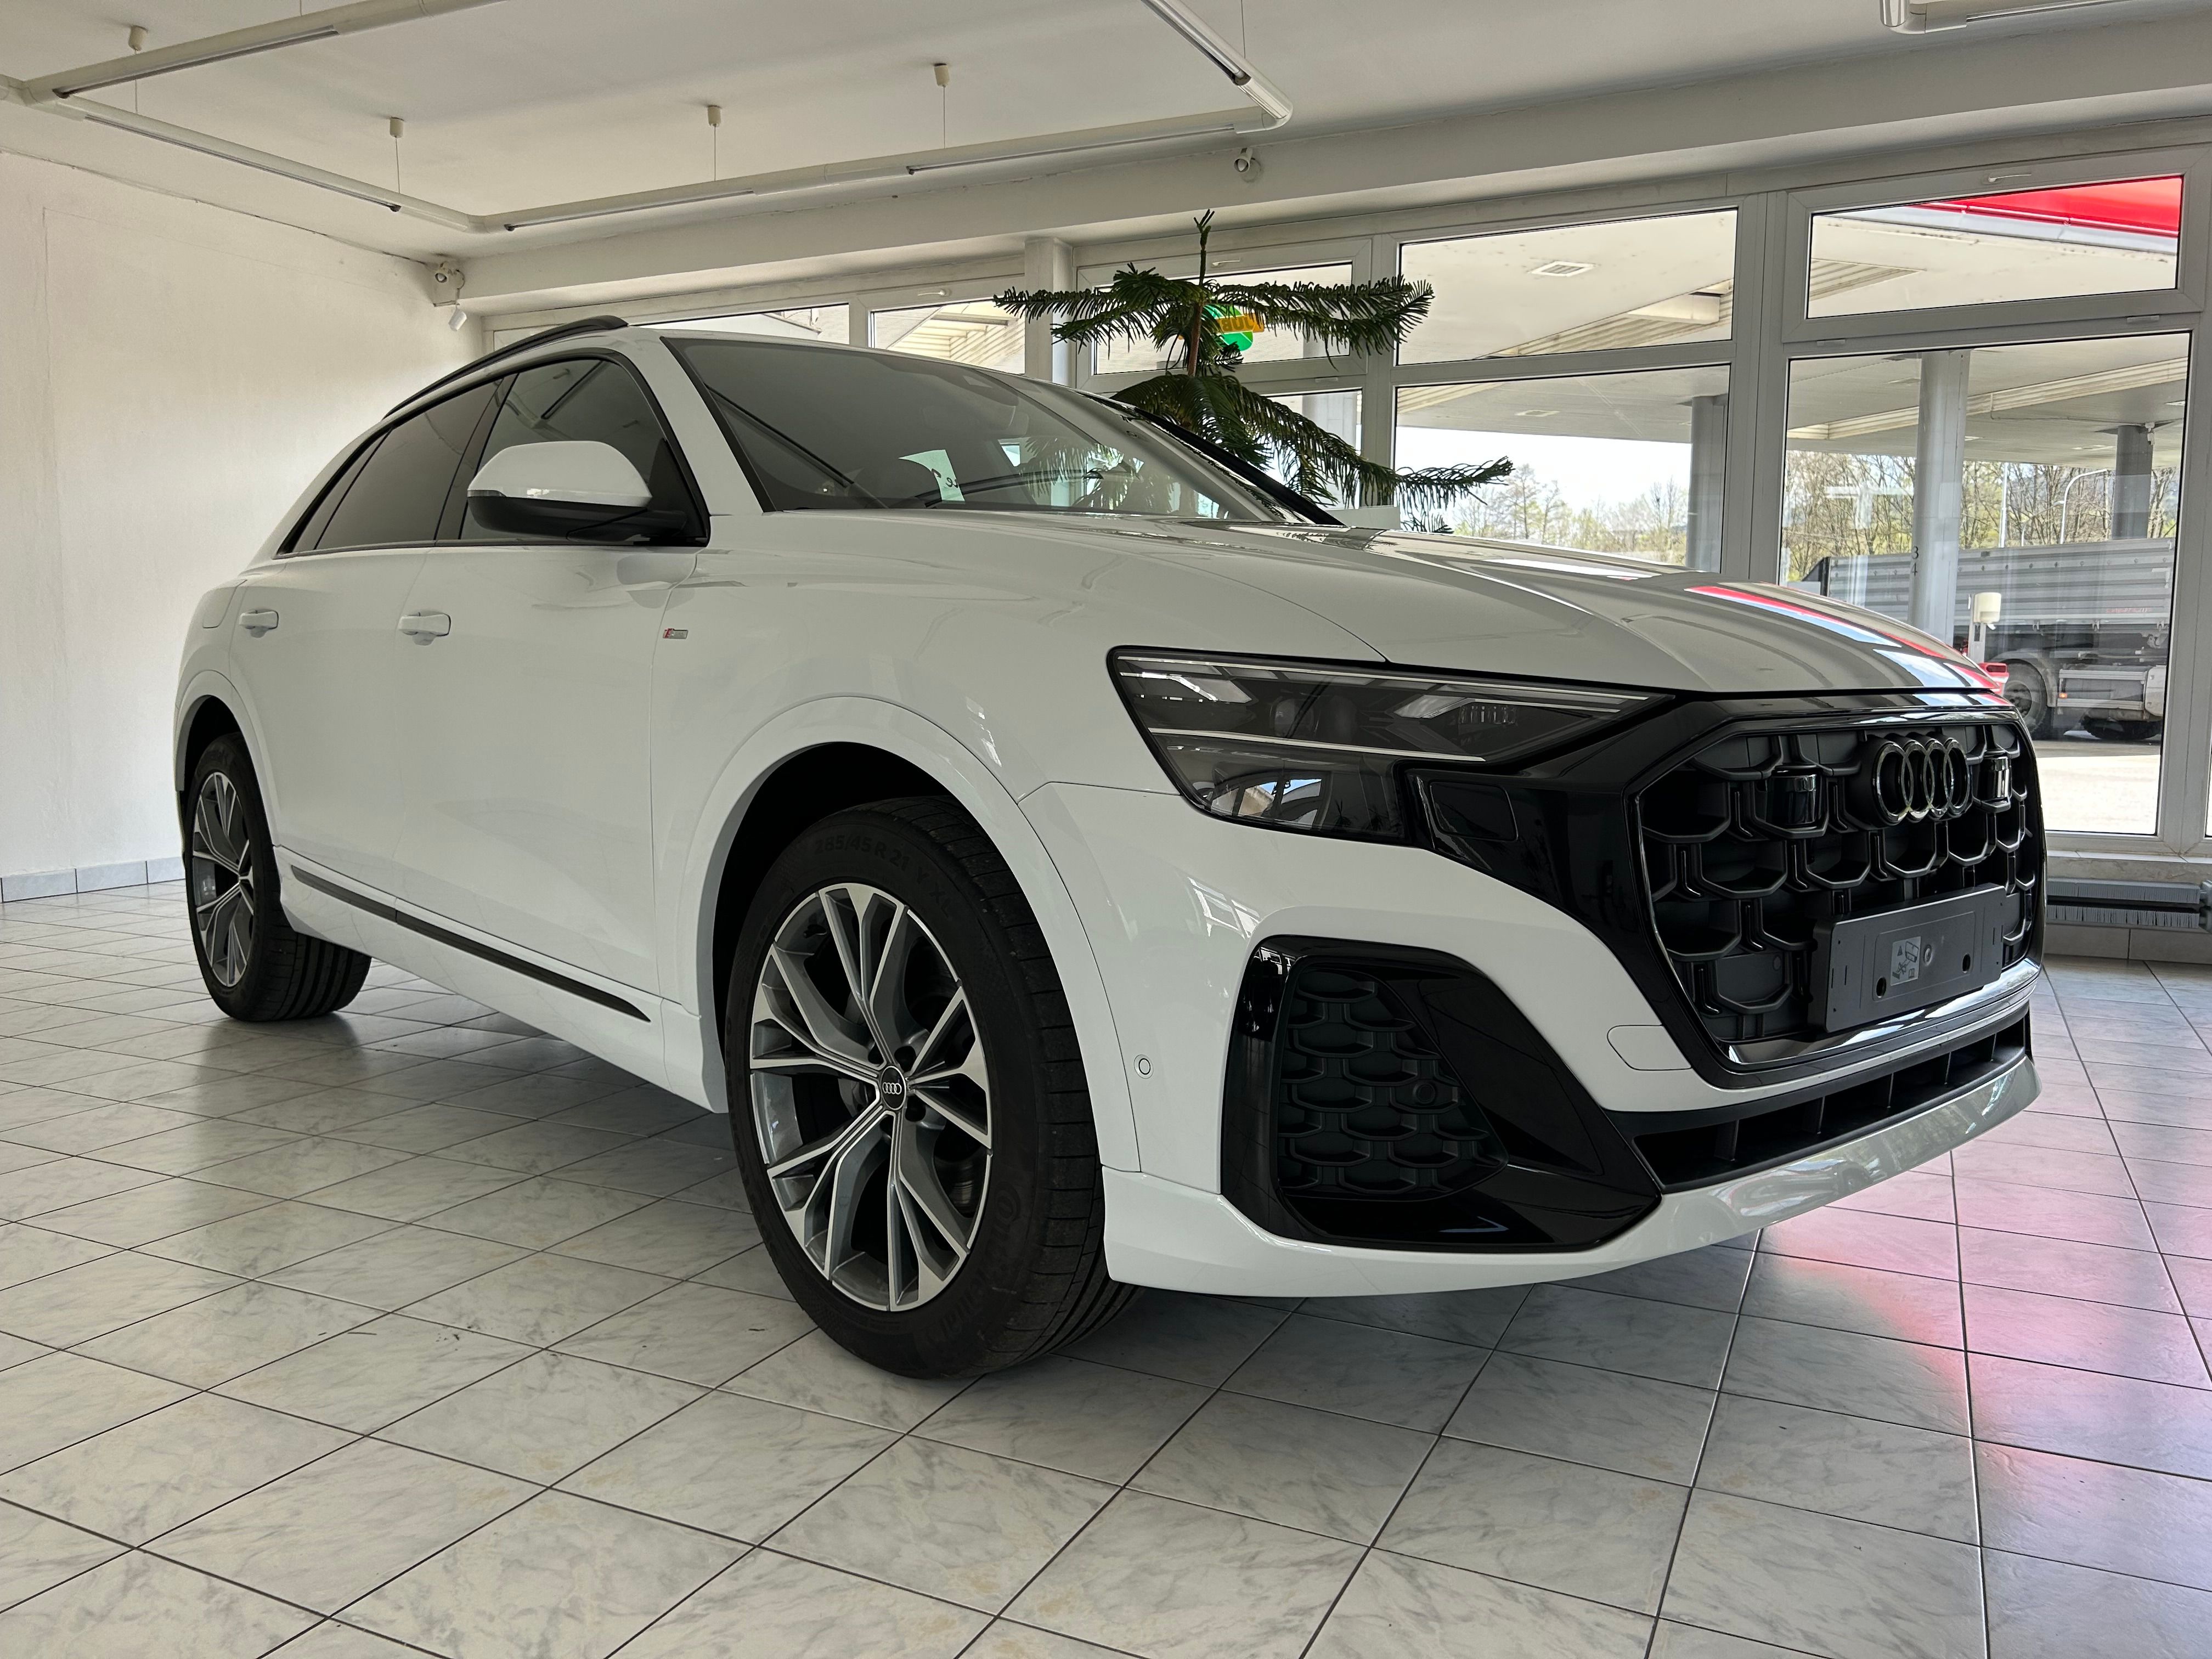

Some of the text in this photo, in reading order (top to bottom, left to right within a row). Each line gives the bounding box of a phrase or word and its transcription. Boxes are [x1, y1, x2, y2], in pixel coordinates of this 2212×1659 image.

[1912, 546, 1919, 560] 3
[1911, 562, 1918, 577] 4
[815, 835, 871, 854] 285/45
[875, 840, 886, 859] R
[890, 848, 909, 872] 21
